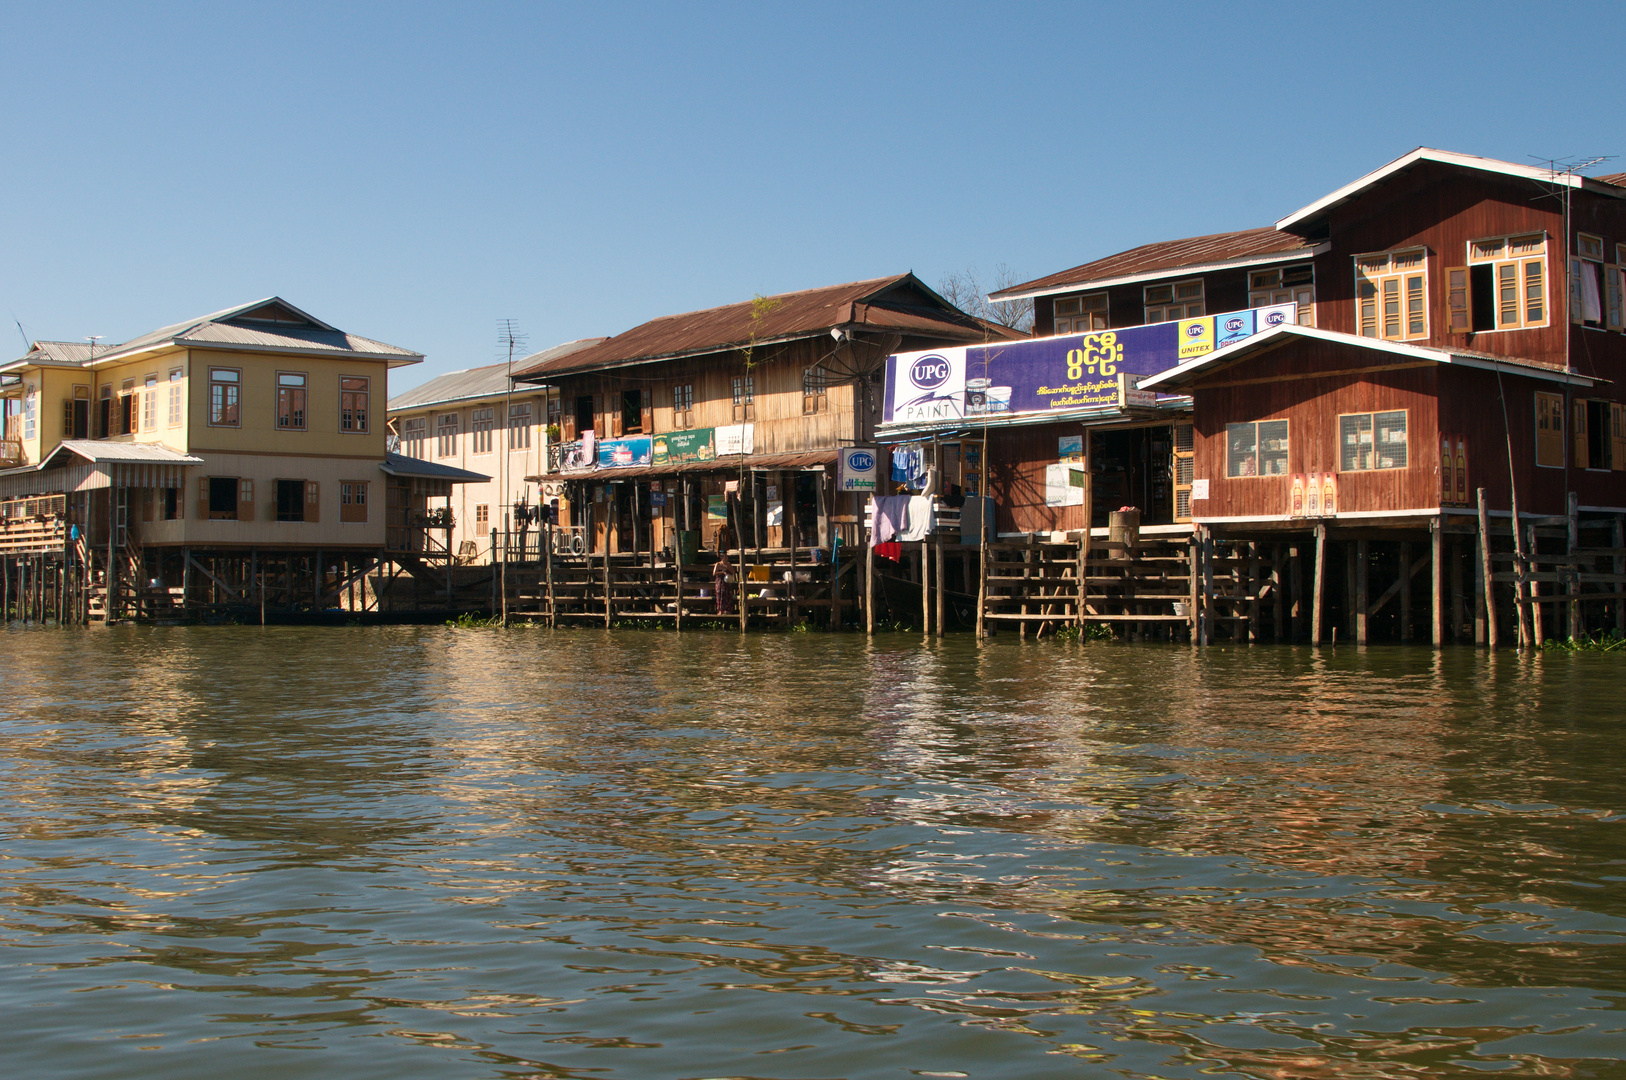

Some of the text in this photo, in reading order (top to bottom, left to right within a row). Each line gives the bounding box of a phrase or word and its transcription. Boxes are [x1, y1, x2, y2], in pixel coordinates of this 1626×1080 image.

[1267, 314, 1284, 323] UPG
[1226, 320, 1244, 329] UPG
[1188, 326, 1204, 335] UPG
[1181, 344, 1210, 354] UNITEX
[914, 362, 947, 381] UPG
[907, 404, 949, 419] PAINT
[986, 403, 1009, 411] ORIENT
[852, 456, 872, 466] UPG
